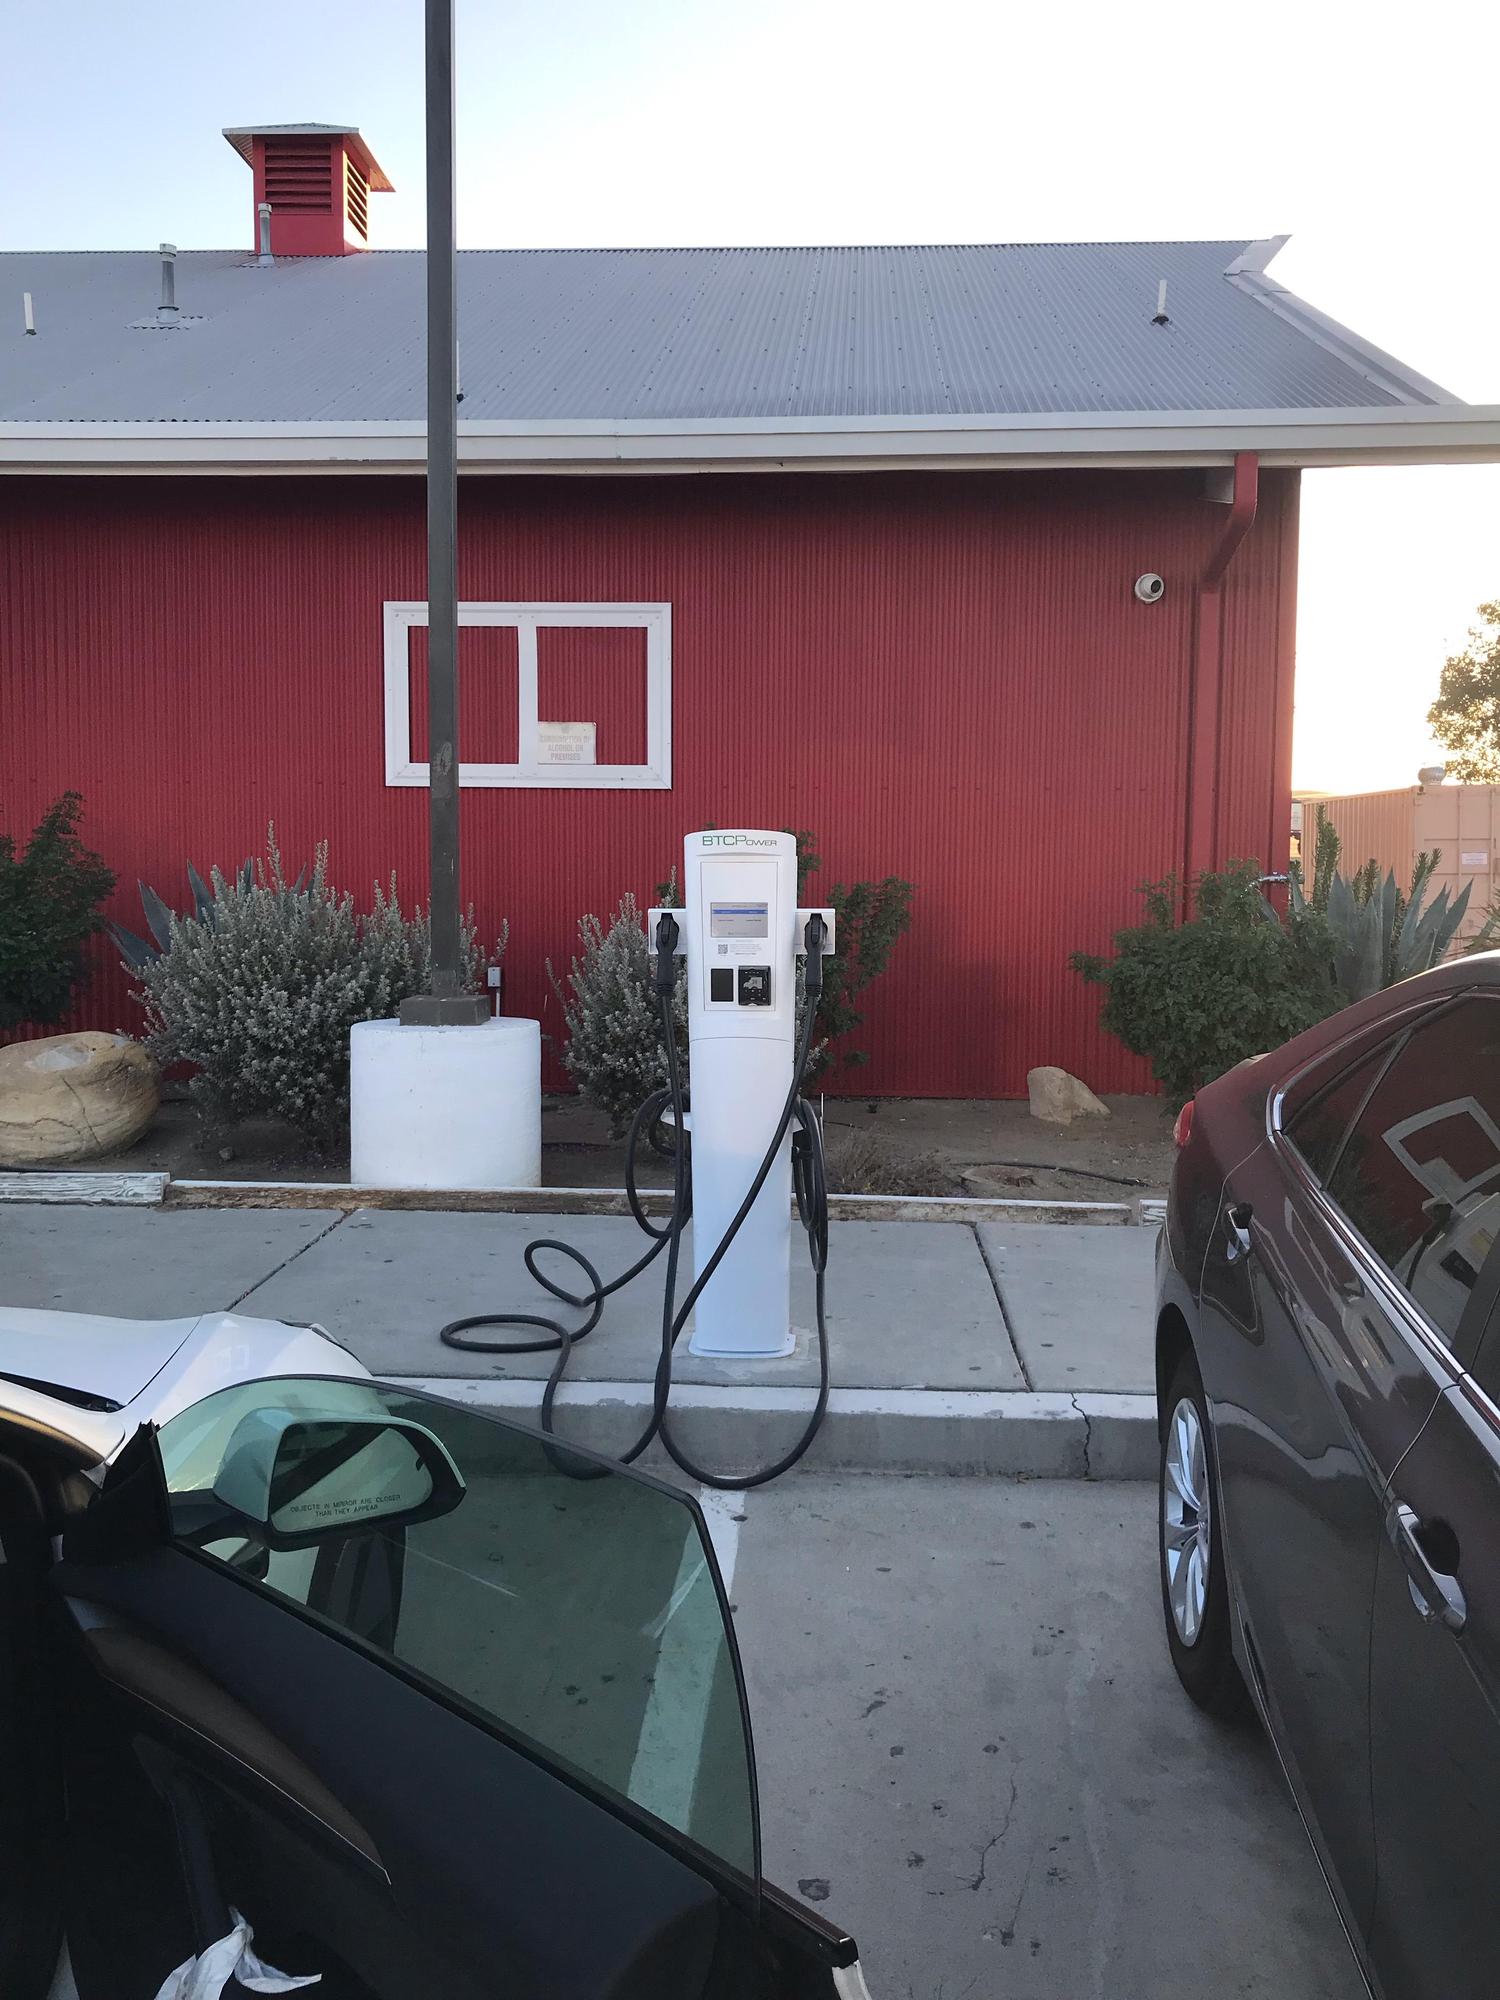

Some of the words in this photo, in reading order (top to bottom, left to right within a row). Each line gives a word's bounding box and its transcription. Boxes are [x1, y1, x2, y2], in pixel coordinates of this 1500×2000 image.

[540, 735, 582, 744] CPTION
[290, 1503, 321, 1513] OBJECTS
[333, 1499, 357, 1508] MIRROR
[375, 1494, 401, 1503] CLOSER
[316, 1509, 332, 1517] THAN
[335, 1507, 350, 1515] THEY
[354, 1504, 378, 1512] APPEAR
